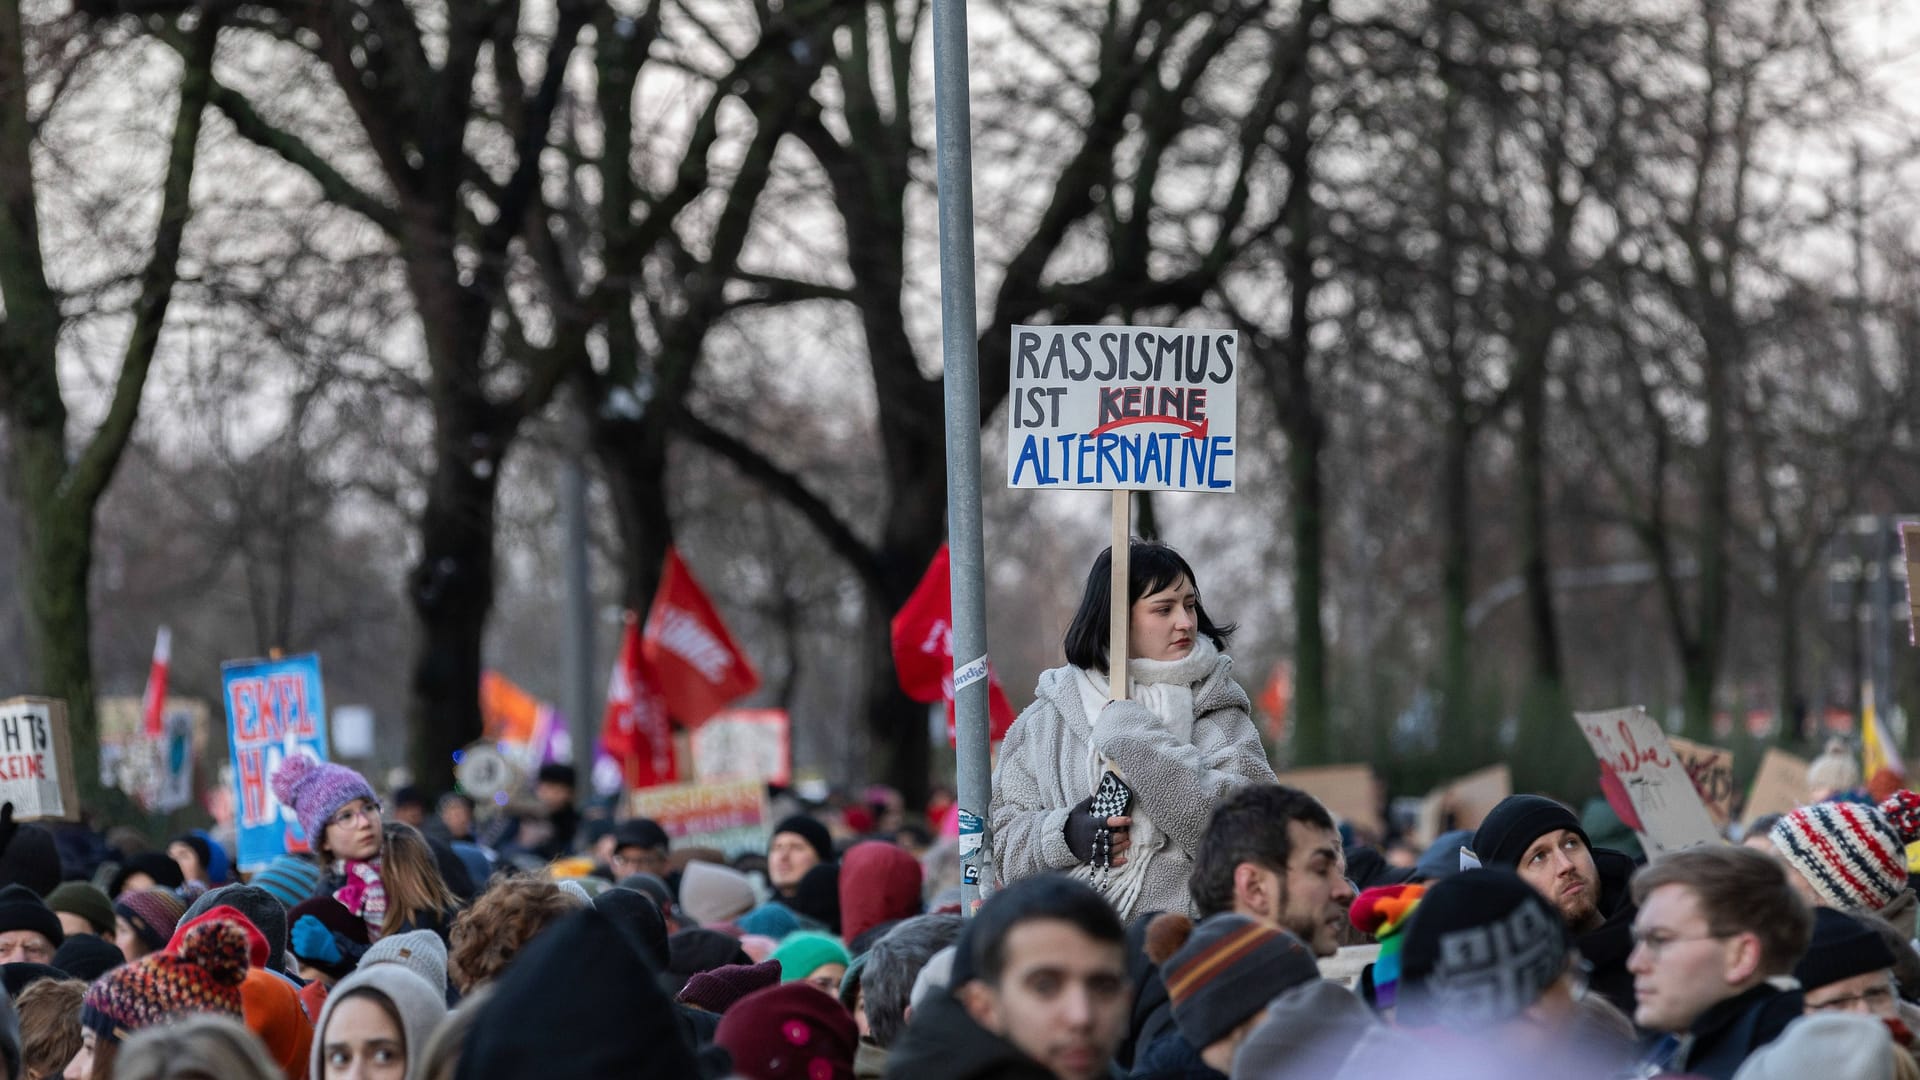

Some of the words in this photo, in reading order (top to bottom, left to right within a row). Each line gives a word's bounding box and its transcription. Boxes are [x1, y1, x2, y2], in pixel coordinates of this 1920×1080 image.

[1016, 331, 1234, 384] RASSISMUS
[1013, 387, 1067, 428] IST
[1099, 386, 1207, 425] KEINE
[1012, 432, 1234, 488] ALTERNATIVE
[230, 672, 317, 743] EKEL
